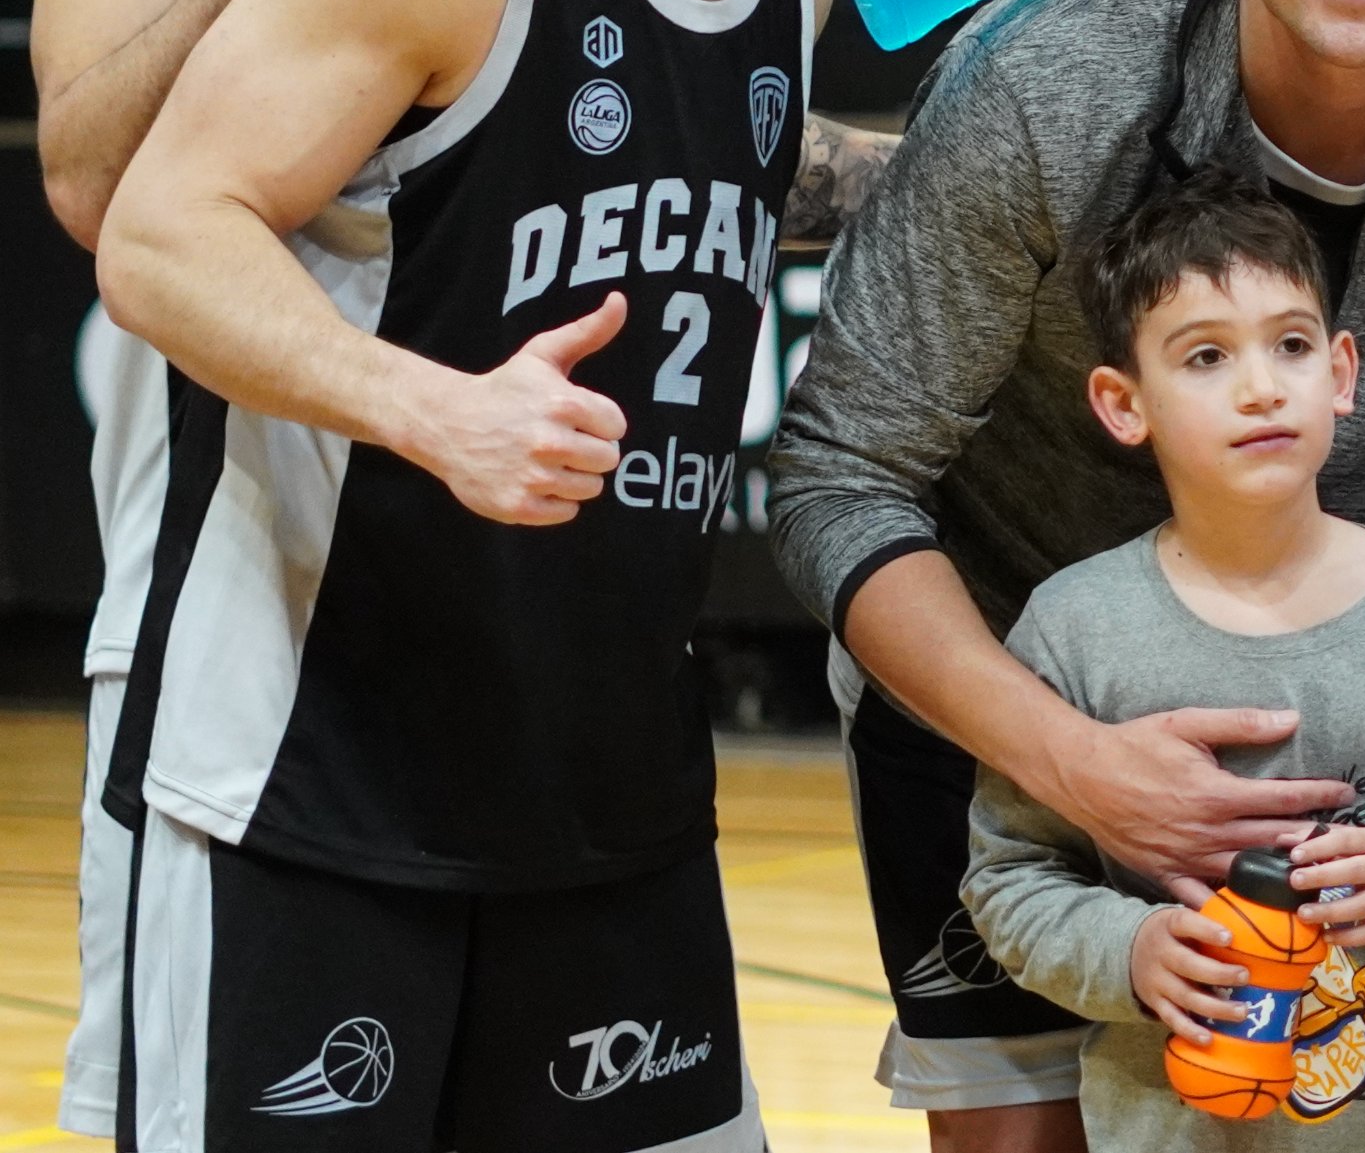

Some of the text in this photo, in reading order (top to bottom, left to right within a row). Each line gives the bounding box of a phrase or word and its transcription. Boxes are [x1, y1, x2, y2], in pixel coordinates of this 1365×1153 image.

[502, 177, 777, 317] DECAN
[653, 291, 711, 406] 2
[614, 435, 736, 534] elay
